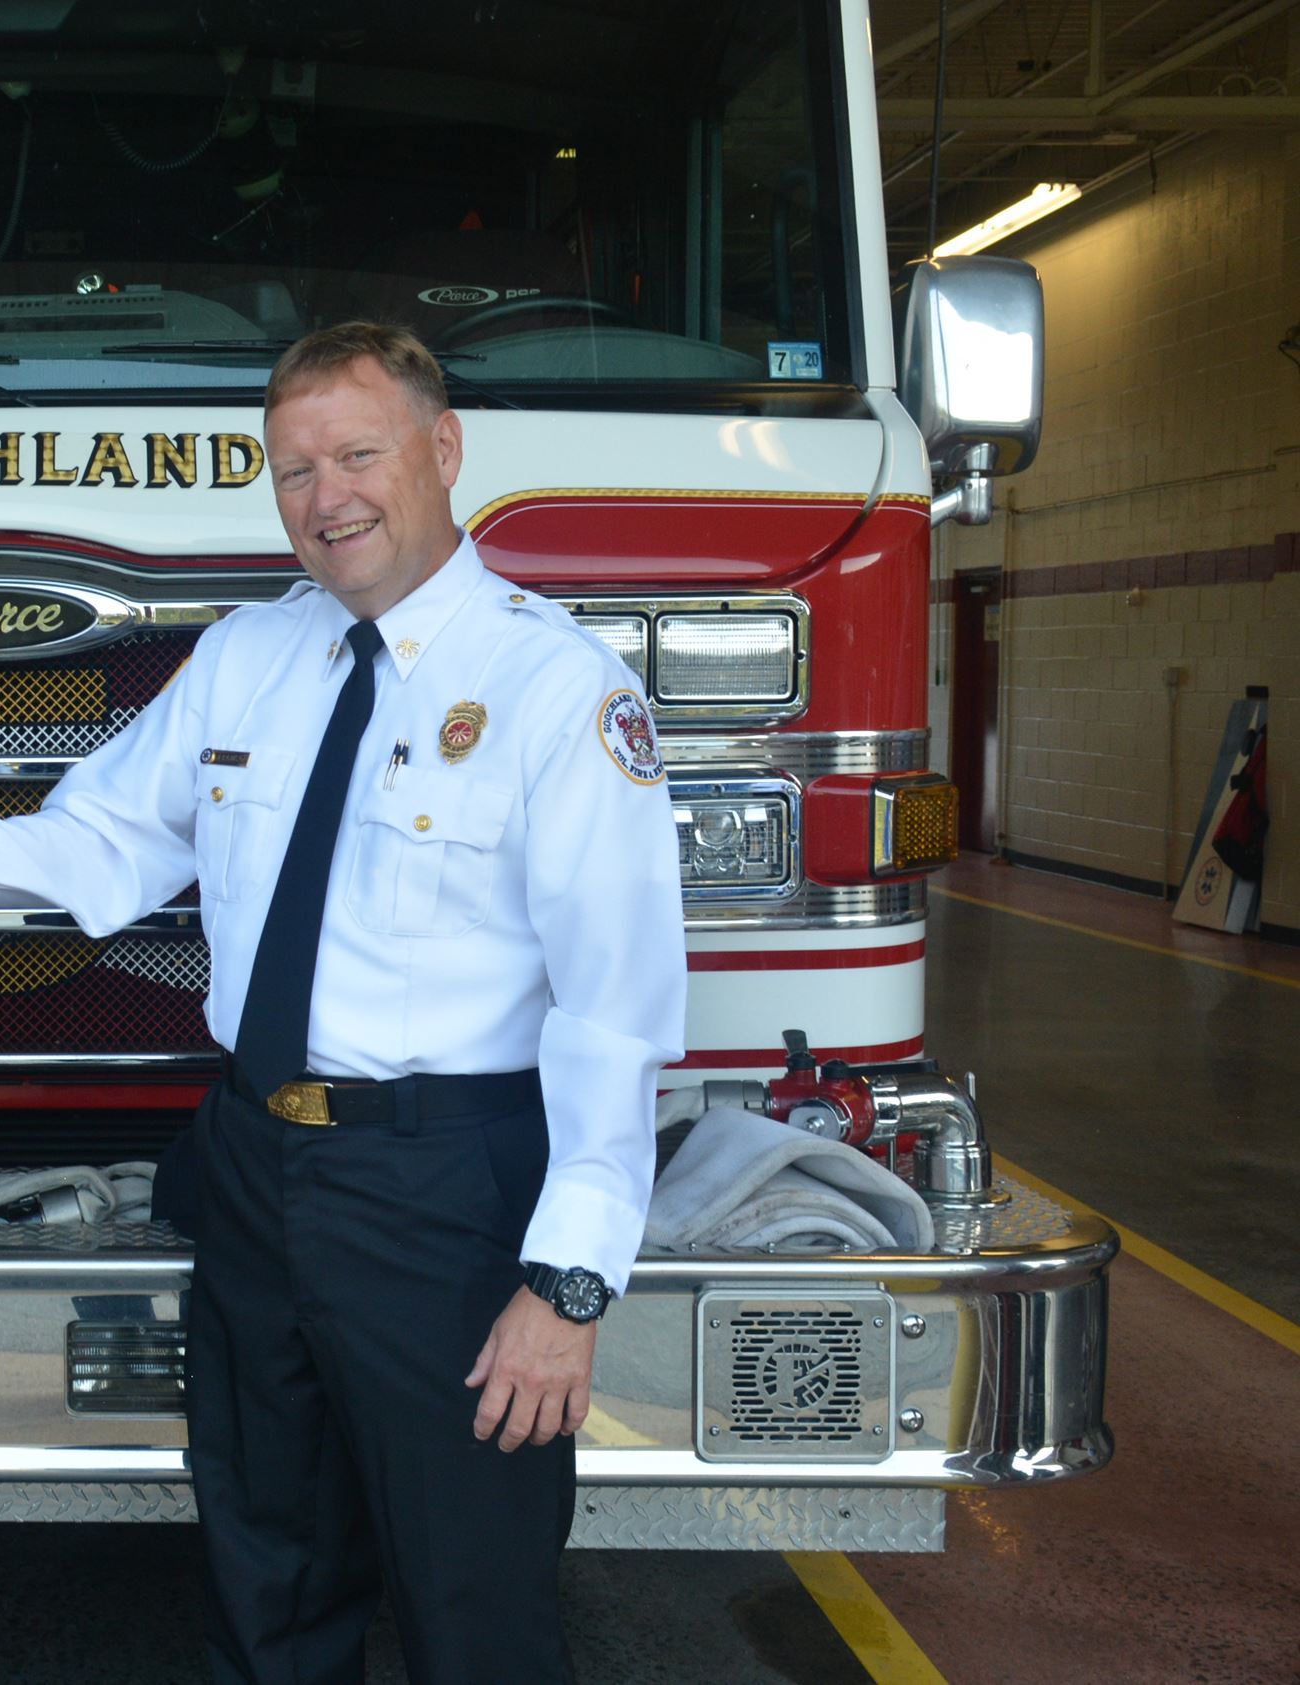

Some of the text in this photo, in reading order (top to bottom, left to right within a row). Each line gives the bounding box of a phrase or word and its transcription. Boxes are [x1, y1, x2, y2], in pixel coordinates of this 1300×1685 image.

[437, 287, 480, 302] Pierce
[774, 351, 819, 371] 7 20
[603, 694, 632, 733] GOOCHLAND
